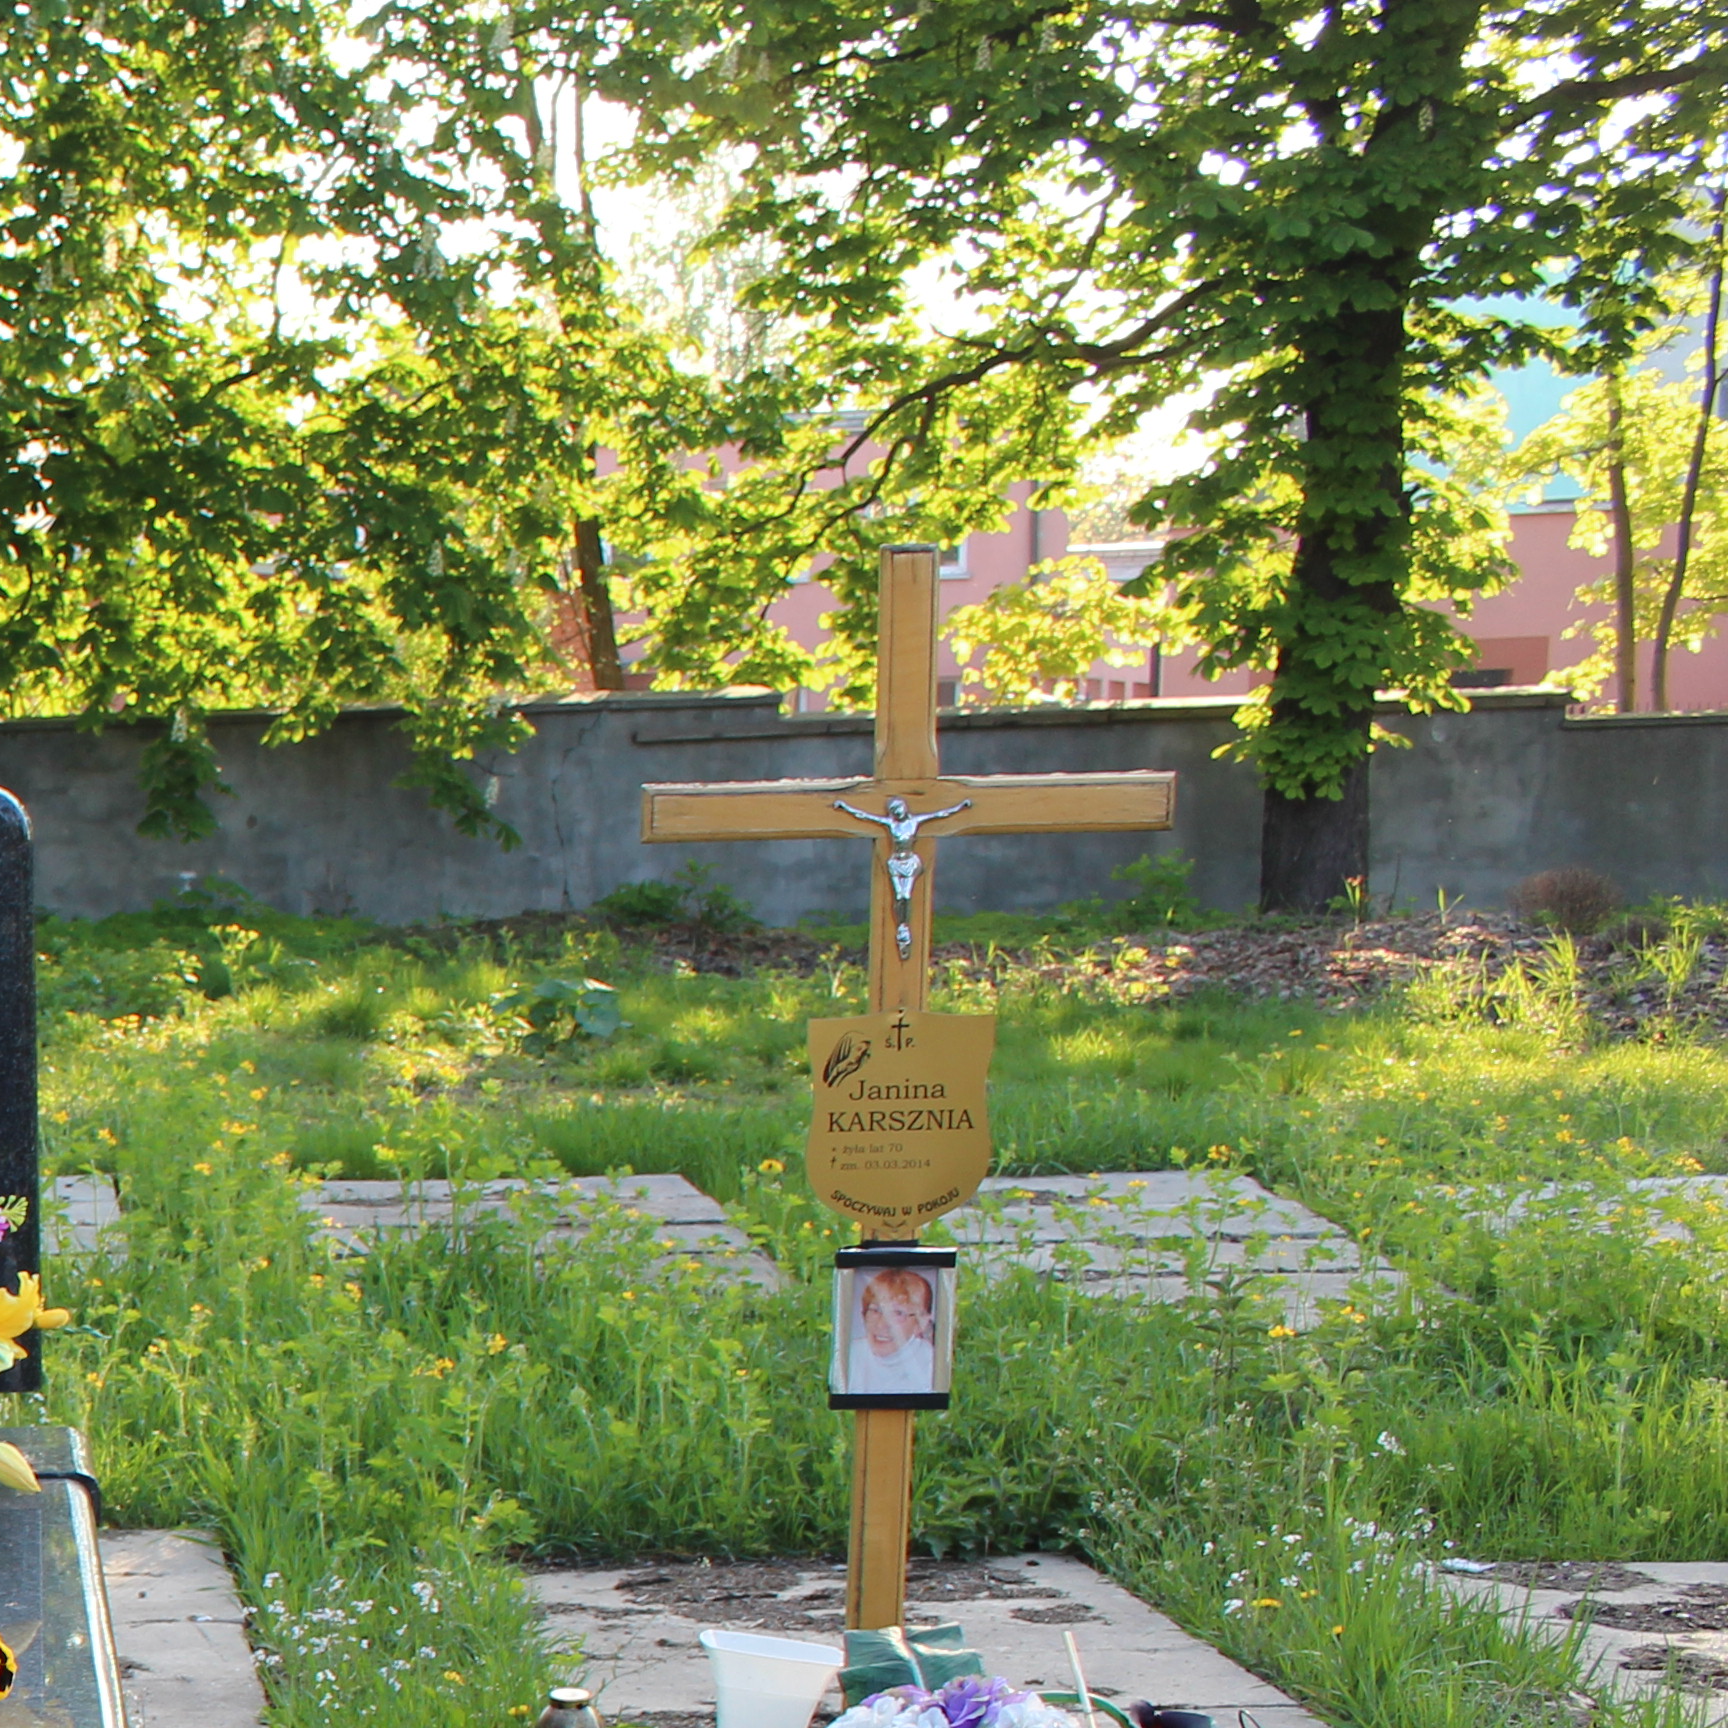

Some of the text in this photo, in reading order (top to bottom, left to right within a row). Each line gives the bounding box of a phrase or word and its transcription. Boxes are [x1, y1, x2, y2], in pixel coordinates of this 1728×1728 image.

[848, 1078, 947, 1101] Janina
[825, 1108, 975, 1133] KARSZNIA
[888, 1143, 903, 1153] 70
[864, 1159, 931, 1170] 03.03.2014
[829, 1187, 960, 1217] SPOCZYWAJ W POKOJU
